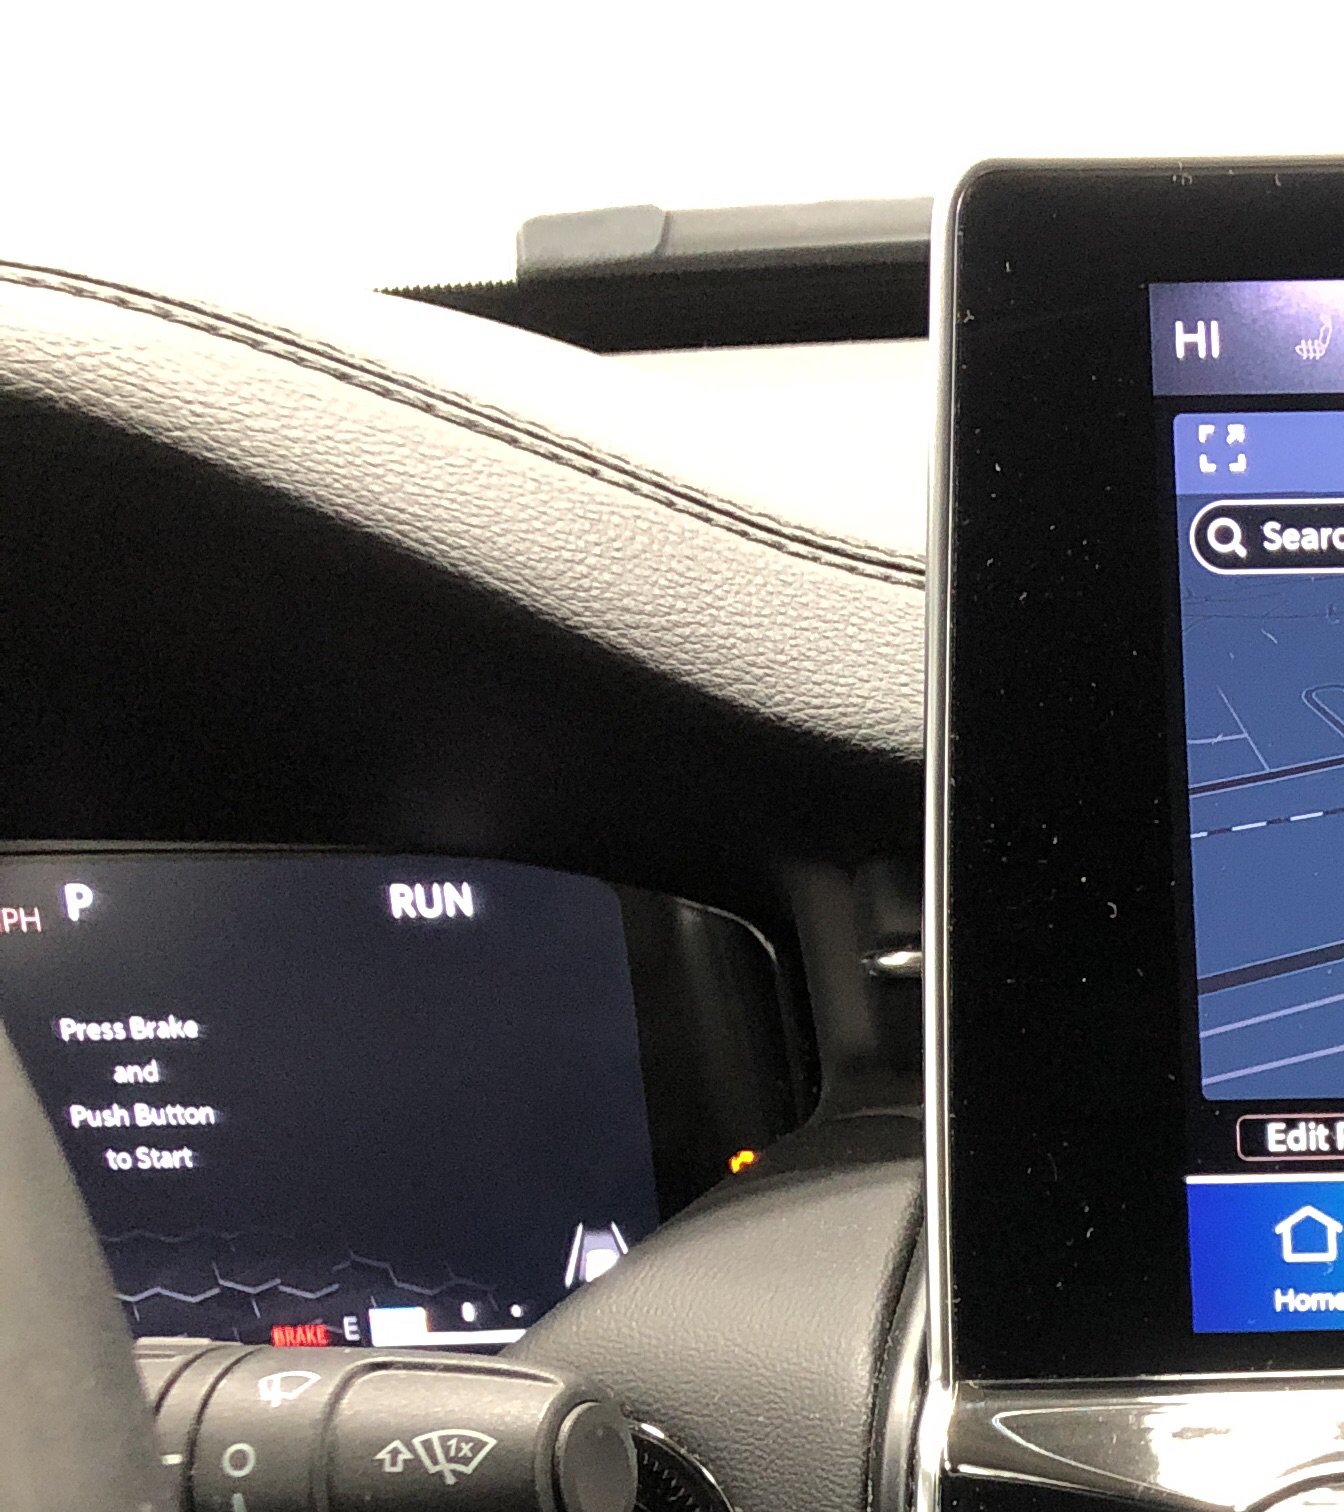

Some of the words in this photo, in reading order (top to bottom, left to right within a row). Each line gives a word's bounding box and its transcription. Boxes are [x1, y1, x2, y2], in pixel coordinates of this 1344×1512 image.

[1175, 320, 1220, 360] HI
[65, 883, 94, 921] P
[389, 882, 474, 918] RUN
[0, 906, 42, 933] PH
[59, 1016, 126, 1041] Press
[130, 1015, 199, 1040] Brake
[113, 1059, 159, 1085] and
[70, 1103, 130, 1128] Push
[135, 1102, 215, 1128] Button
[1266, 1121, 1330, 1152] Edit
[106, 1147, 132, 1171] to
[137, 1146, 193, 1171] Start
[272, 1324, 329, 1347] BRAKE
[343, 1315, 361, 1341] E
